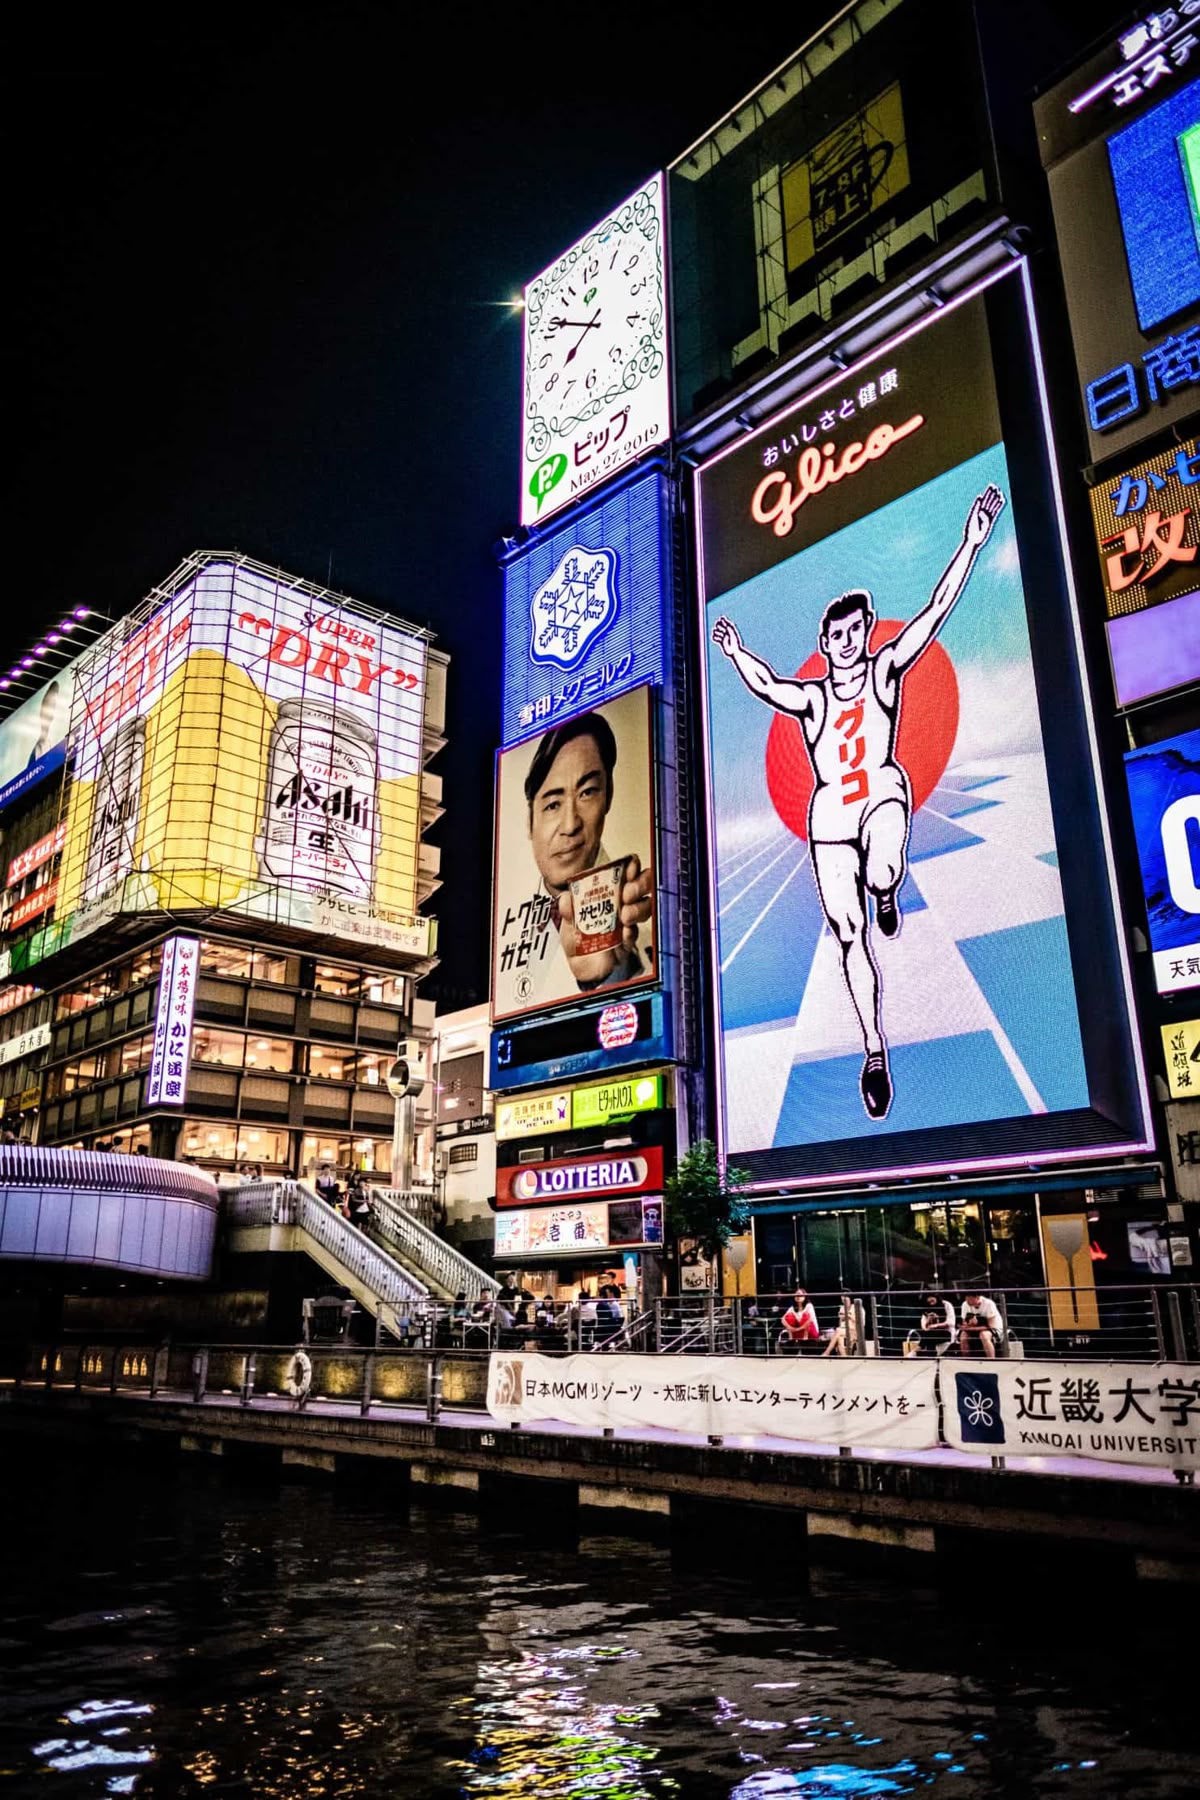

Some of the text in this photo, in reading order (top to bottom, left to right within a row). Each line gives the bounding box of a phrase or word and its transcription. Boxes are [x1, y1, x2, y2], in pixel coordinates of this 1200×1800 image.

[582, 260, 599, 284] 12
[609, 249, 618, 270] 1
[623, 255, 639, 276] 2
[561, 286, 577, 307] 11
[630, 277, 647, 297] 3
[626, 311, 640, 328] 4
[539, 353, 553, 369] 9
[609, 344, 622, 363] 5
[545, 372, 559, 392] 8
[563, 379, 577, 399] 7
[585, 369, 597, 389] 6
[763, 368, 898, 467] おいしさと健康
[574, 404, 631, 467] ピップ
[623, 424, 659, 455] 2019
[751, 413, 925, 537] Glico
[1099, 507, 1199, 592] 改
[300, 611, 377, 653] SUPER
[833, 698, 870, 805] グリコ
[275, 769, 369, 831] Asahi
[307, 828, 336, 854] 生
[501, 894, 551, 937] トクホ
[500, 931, 550, 973] ガセリ
[175, 963, 191, 1017] 本場の味
[166, 1021, 187, 1098] かに道楽
[598, 1085, 634, 1112] ピタットハウス
[541, 1161, 635, 1192] LOTTERIA
[525, 1379, 642, 1401] 日本MGMリゾーツ
[1013, 1377, 1200, 1427] 近畿大学
[1019, 1431, 1083, 1450] KINDAI
